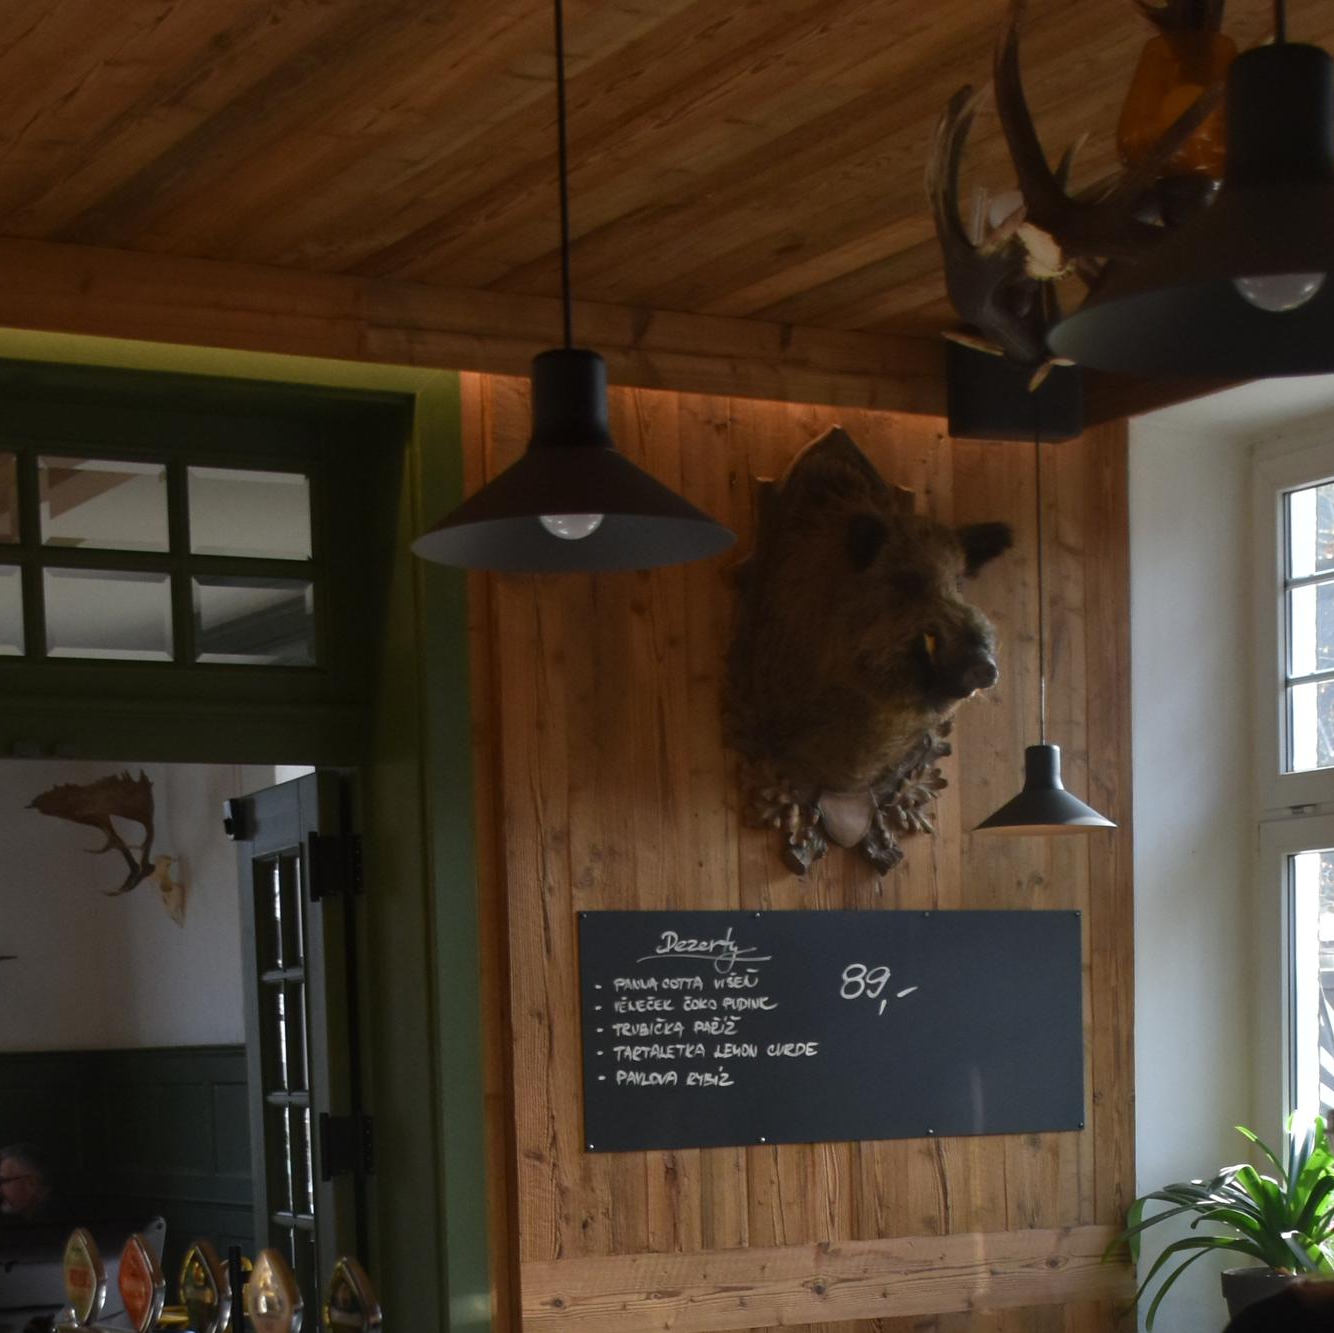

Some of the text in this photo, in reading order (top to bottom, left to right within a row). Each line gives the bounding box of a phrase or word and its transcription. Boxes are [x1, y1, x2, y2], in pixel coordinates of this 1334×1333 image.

[655, 927, 758, 974] Dezerty
[661, 976, 703, 991] COTTA
[683, 996, 717, 1011] ČOKO
[612, 1016, 685, 1038] TRUBIČKA
[613, 1041, 819, 1062] TARTALETKA LEMON CURDE
[616, 1070, 678, 1086] PAVLOVA
